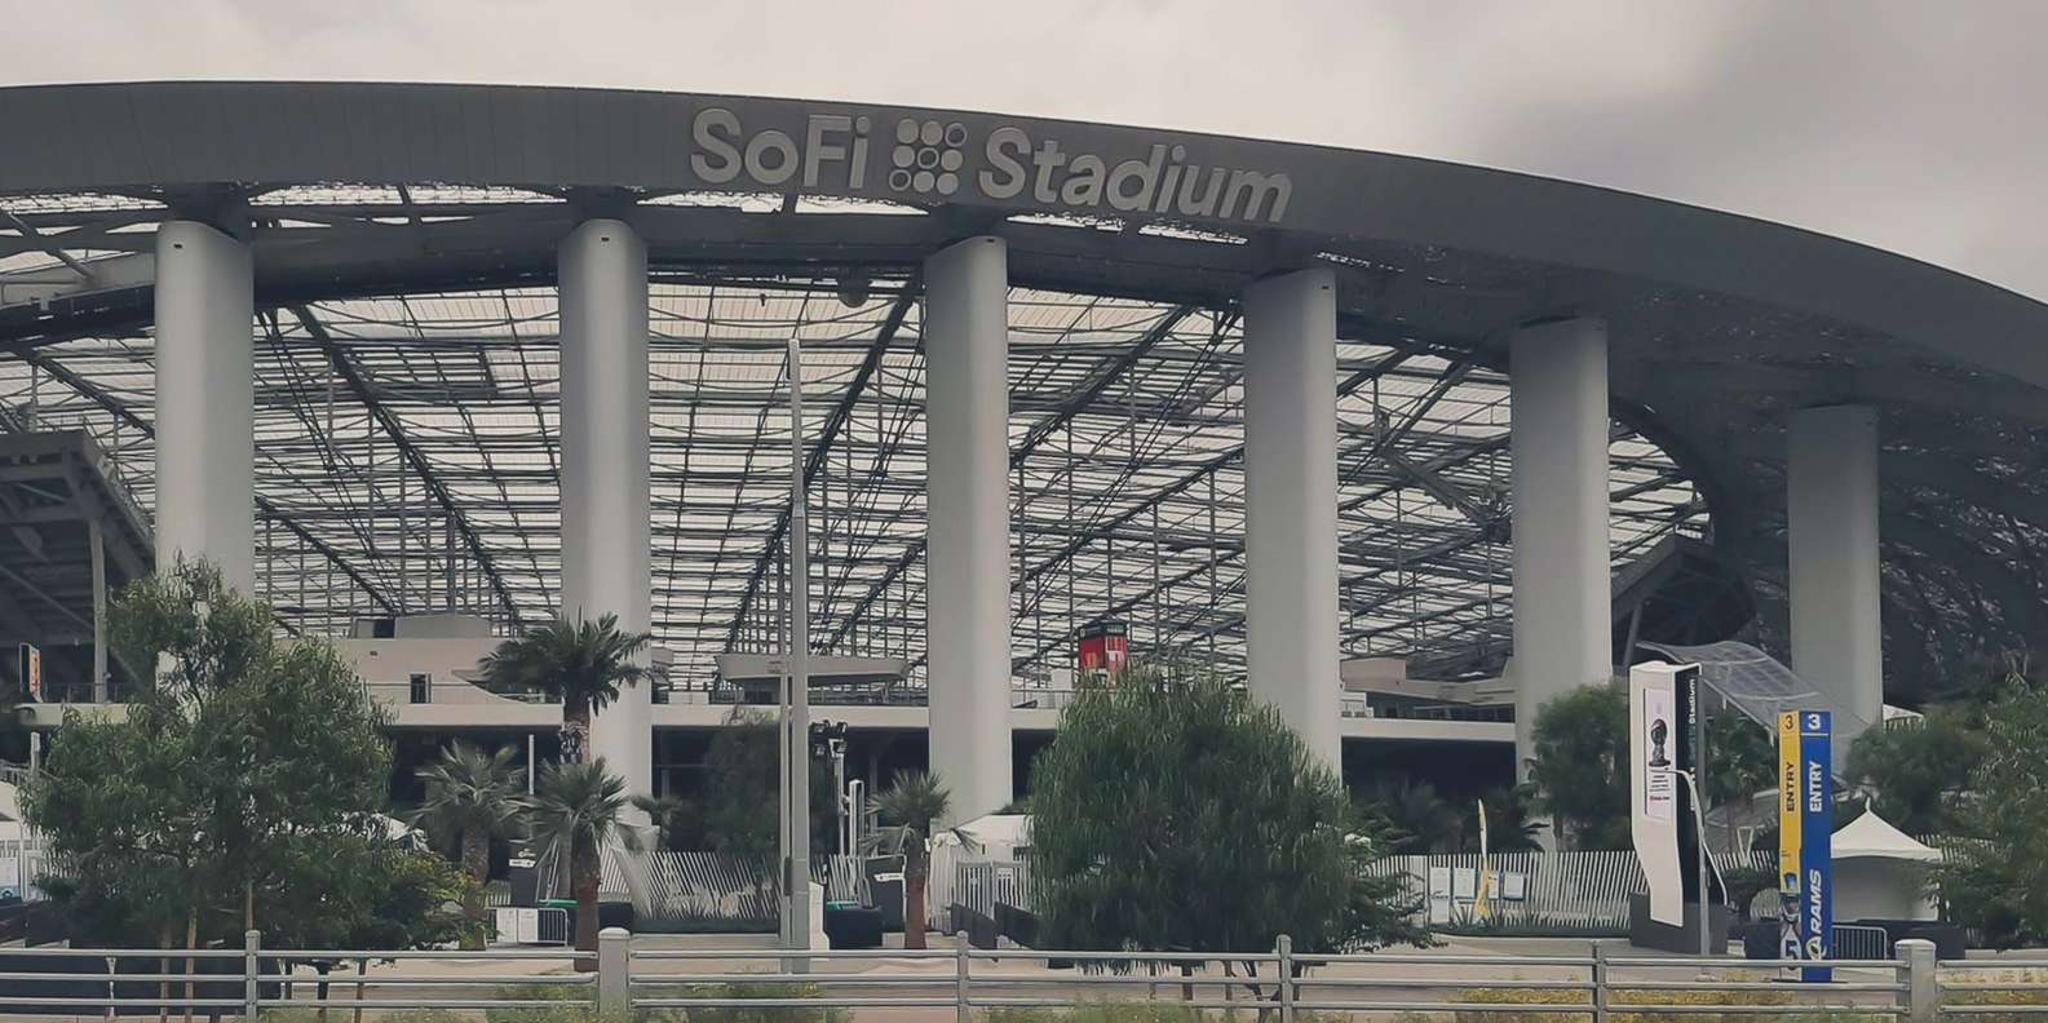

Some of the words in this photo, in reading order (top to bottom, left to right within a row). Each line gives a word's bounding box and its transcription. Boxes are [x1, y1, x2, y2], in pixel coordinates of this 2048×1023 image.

[691, 108, 871, 189] SoFi
[980, 127, 1293, 222] Stadium
[1785, 714, 1794, 730] 3
[1808, 713, 1821, 730] 3
[1786, 762, 1795, 812] ENTRY
[1809, 760, 1822, 812] ENTRY
[1810, 869, 1821, 934] RAMS
